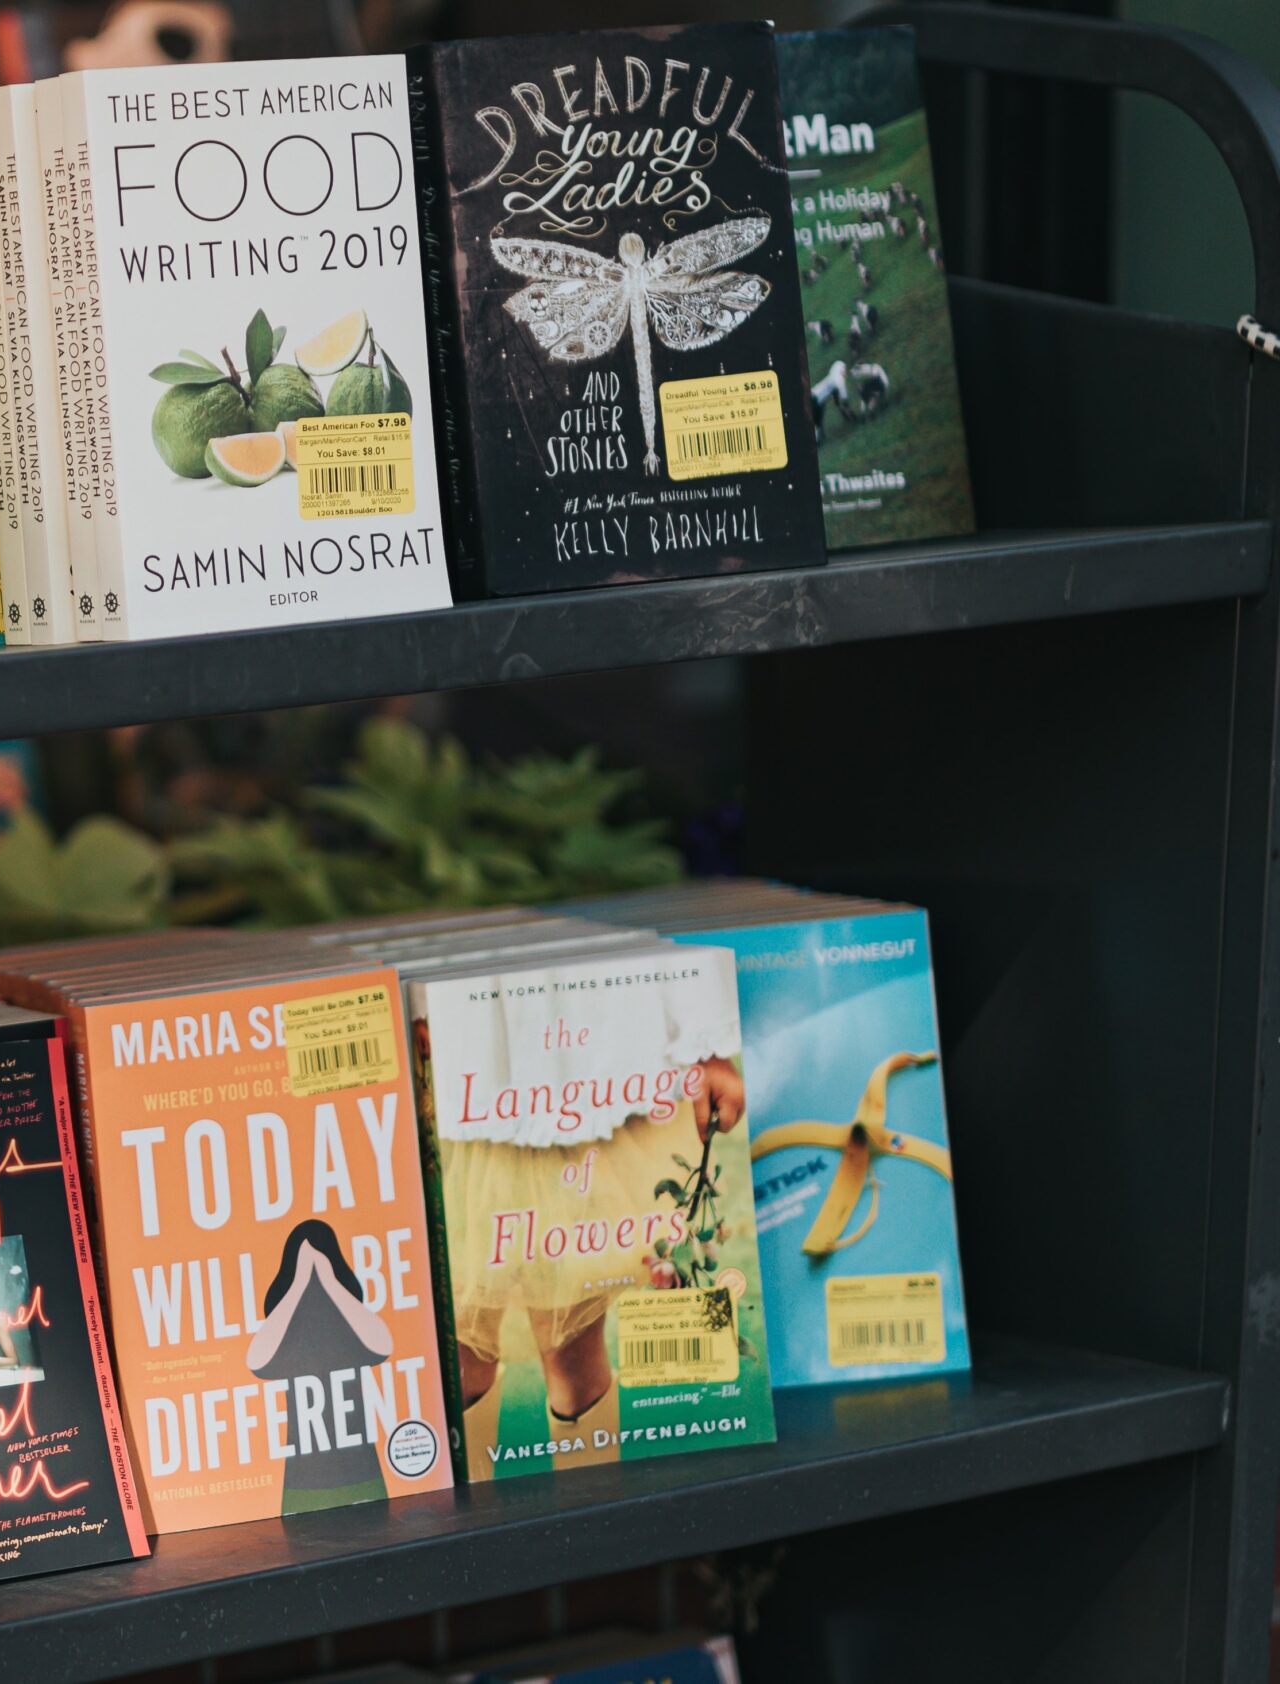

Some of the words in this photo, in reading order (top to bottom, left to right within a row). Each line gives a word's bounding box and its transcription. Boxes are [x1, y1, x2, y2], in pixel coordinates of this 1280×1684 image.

[108, 93, 157, 124] THE
[170, 88, 250, 120] BEST
[260, 81, 394, 116] AMERICAN
[453, 56, 780, 196] DREADFUL
[77, 140, 90, 171] THE
[522, 123, 714, 180] Young
[67, 162, 78, 210] SAMIN
[80, 178, 94, 223] BEST
[114, 131, 403, 227] FOOD
[502, 160, 712, 226] Ladies
[819, 186, 891, 215] Holiday
[72, 217, 84, 277] NOSRAT
[319, 224, 408, 271] 2019
[817, 220, 885, 243] Human
[84, 228, 102, 318] AMERICAN
[78, 301, 89, 354] SILVIA
[92, 324, 108, 389] FOOD
[582, 371, 620, 404] AND
[665, 389, 699, 400] Dreadful
[702, 387, 727, 397] Young
[83, 360, 101, 498] KILLINGSWORTH
[98, 394, 115, 473] WRITING
[302, 424, 319, 432] Best
[322, 422, 358, 431] American
[361, 421, 375, 429] Foo
[377, 417, 407, 428] $7.98
[560, 405, 623, 435] OTHER
[317, 450, 334, 458] You
[363, 446, 386, 456] $8.01
[545, 435, 628, 478] STORIES
[104, 478, 118, 517] 2019
[606, 493, 626, 513] York
[627, 491, 655, 507] Times
[660, 487, 709, 503] BESTSELLING
[711, 483, 742, 499] AUTHOR
[825, 469, 906, 495] Thwaites
[553, 515, 629, 562] KELLY
[649, 505, 764, 554] BARNHILL
[143, 544, 267, 593] SAMIN
[283, 527, 434, 579] NOSRAT
[269, 590, 319, 606] EDITOR
[812, 938, 916, 965] VONNEGUT
[470, 991, 501, 1001] NEW
[507, 986, 546, 997] YORK
[552, 980, 597, 993] TIMES
[605, 968, 700, 987] BESTSELLER
[111, 1010, 241, 1068] MARIA
[543, 1018, 590, 1050] the
[143, 1087, 214, 1112] WHERE'D
[218, 1082, 249, 1102] YOU
[457, 1064, 705, 1132] Language
[121, 1092, 398, 1238] TODAY
[562, 1149, 598, 1193] of
[78, 1238, 88, 1264] TIMES
[489, 1209, 686, 1265] Flowers
[132, 1252, 266, 1348] WILL
[351, 1228, 419, 1315] BE
[144, 1355, 425, 1478] DIFFERENT
[7, 1440, 27, 1454] NEW
[28, 1435, 50, 1450] YORK
[51, 1426, 80, 1442] TIMES
[19, 1444, 71, 1464] BESTSELLER
[487, 1437, 585, 1464] VANESSA
[592, 1415, 747, 1448] DIFFENBAUGH
[114, 1445, 126, 1480] BOSTON
[122, 1481, 134, 1511] GLOBE
[152, 1483, 206, 1502] NATIONAL
[209, 1474, 273, 1497] BESTSELLER
[15, 1506, 87, 1526] FLAMETHROWERS
[23, 1526, 80, 1543] compassionate,
